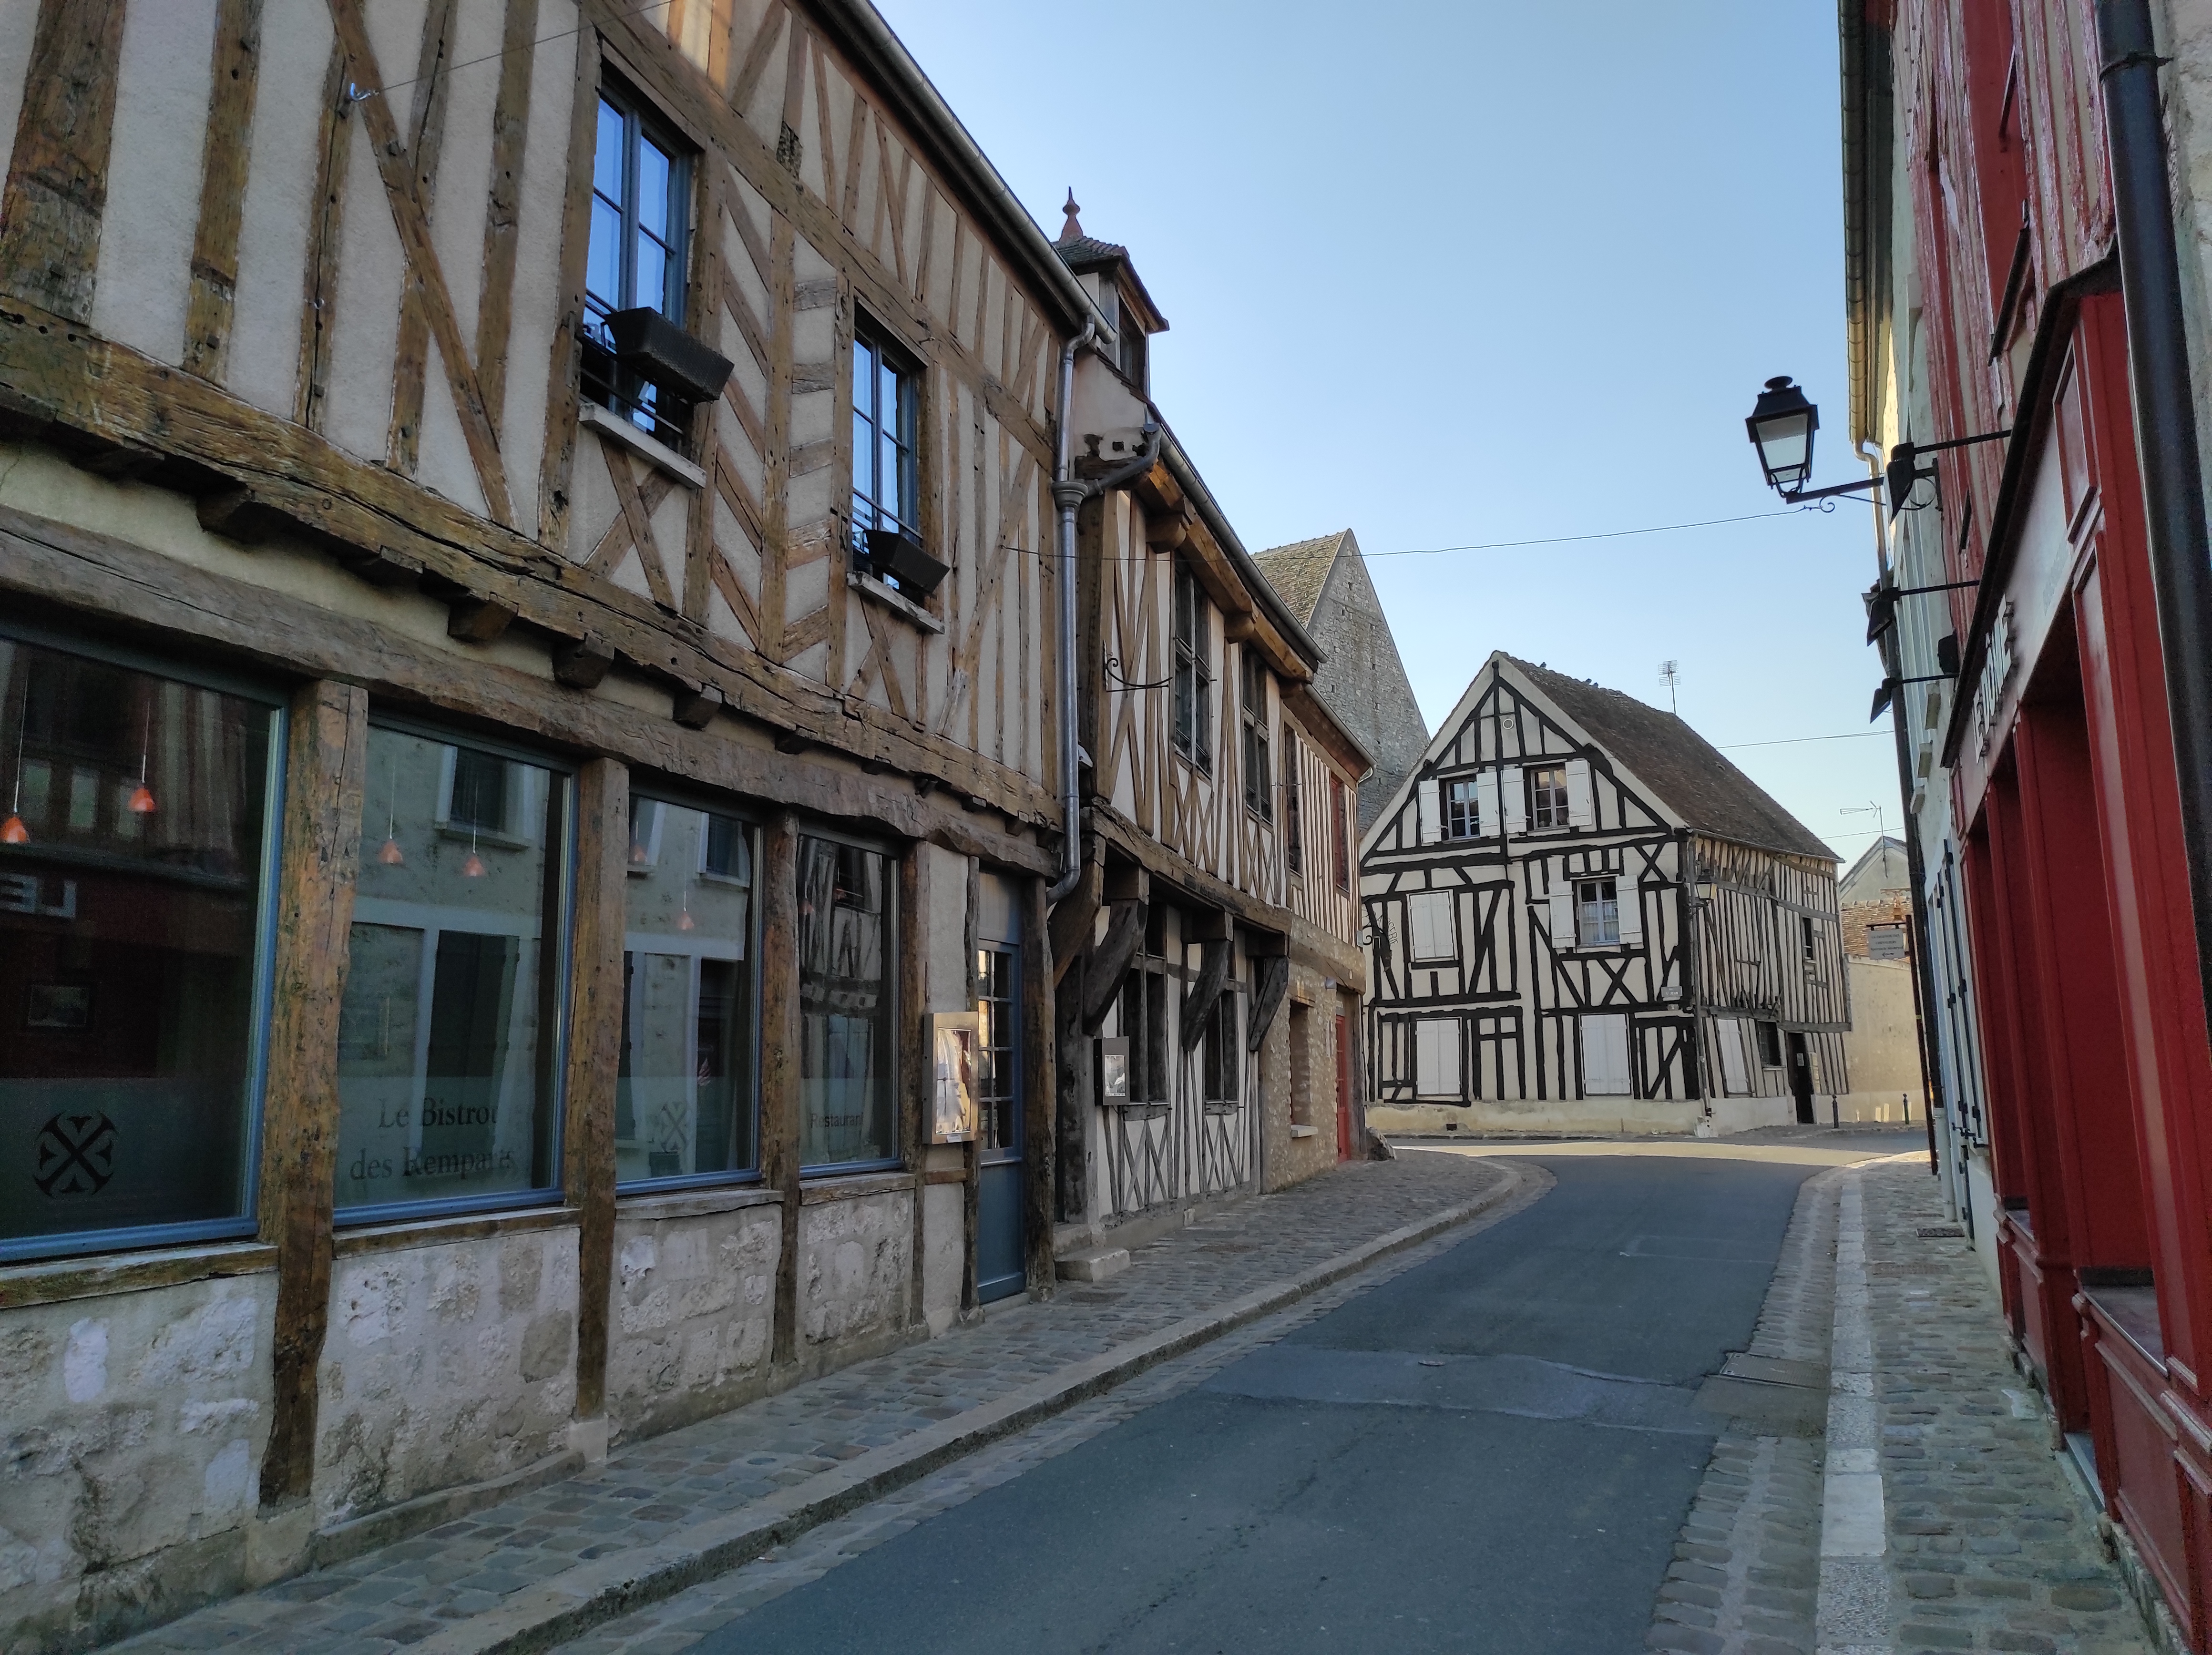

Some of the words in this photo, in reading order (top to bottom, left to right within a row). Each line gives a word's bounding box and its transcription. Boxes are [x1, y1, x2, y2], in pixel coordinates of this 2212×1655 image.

[1972, 687, 1984, 765] LE
[378, 1098, 410, 1128] Le
[349, 1148, 392, 1181] des
